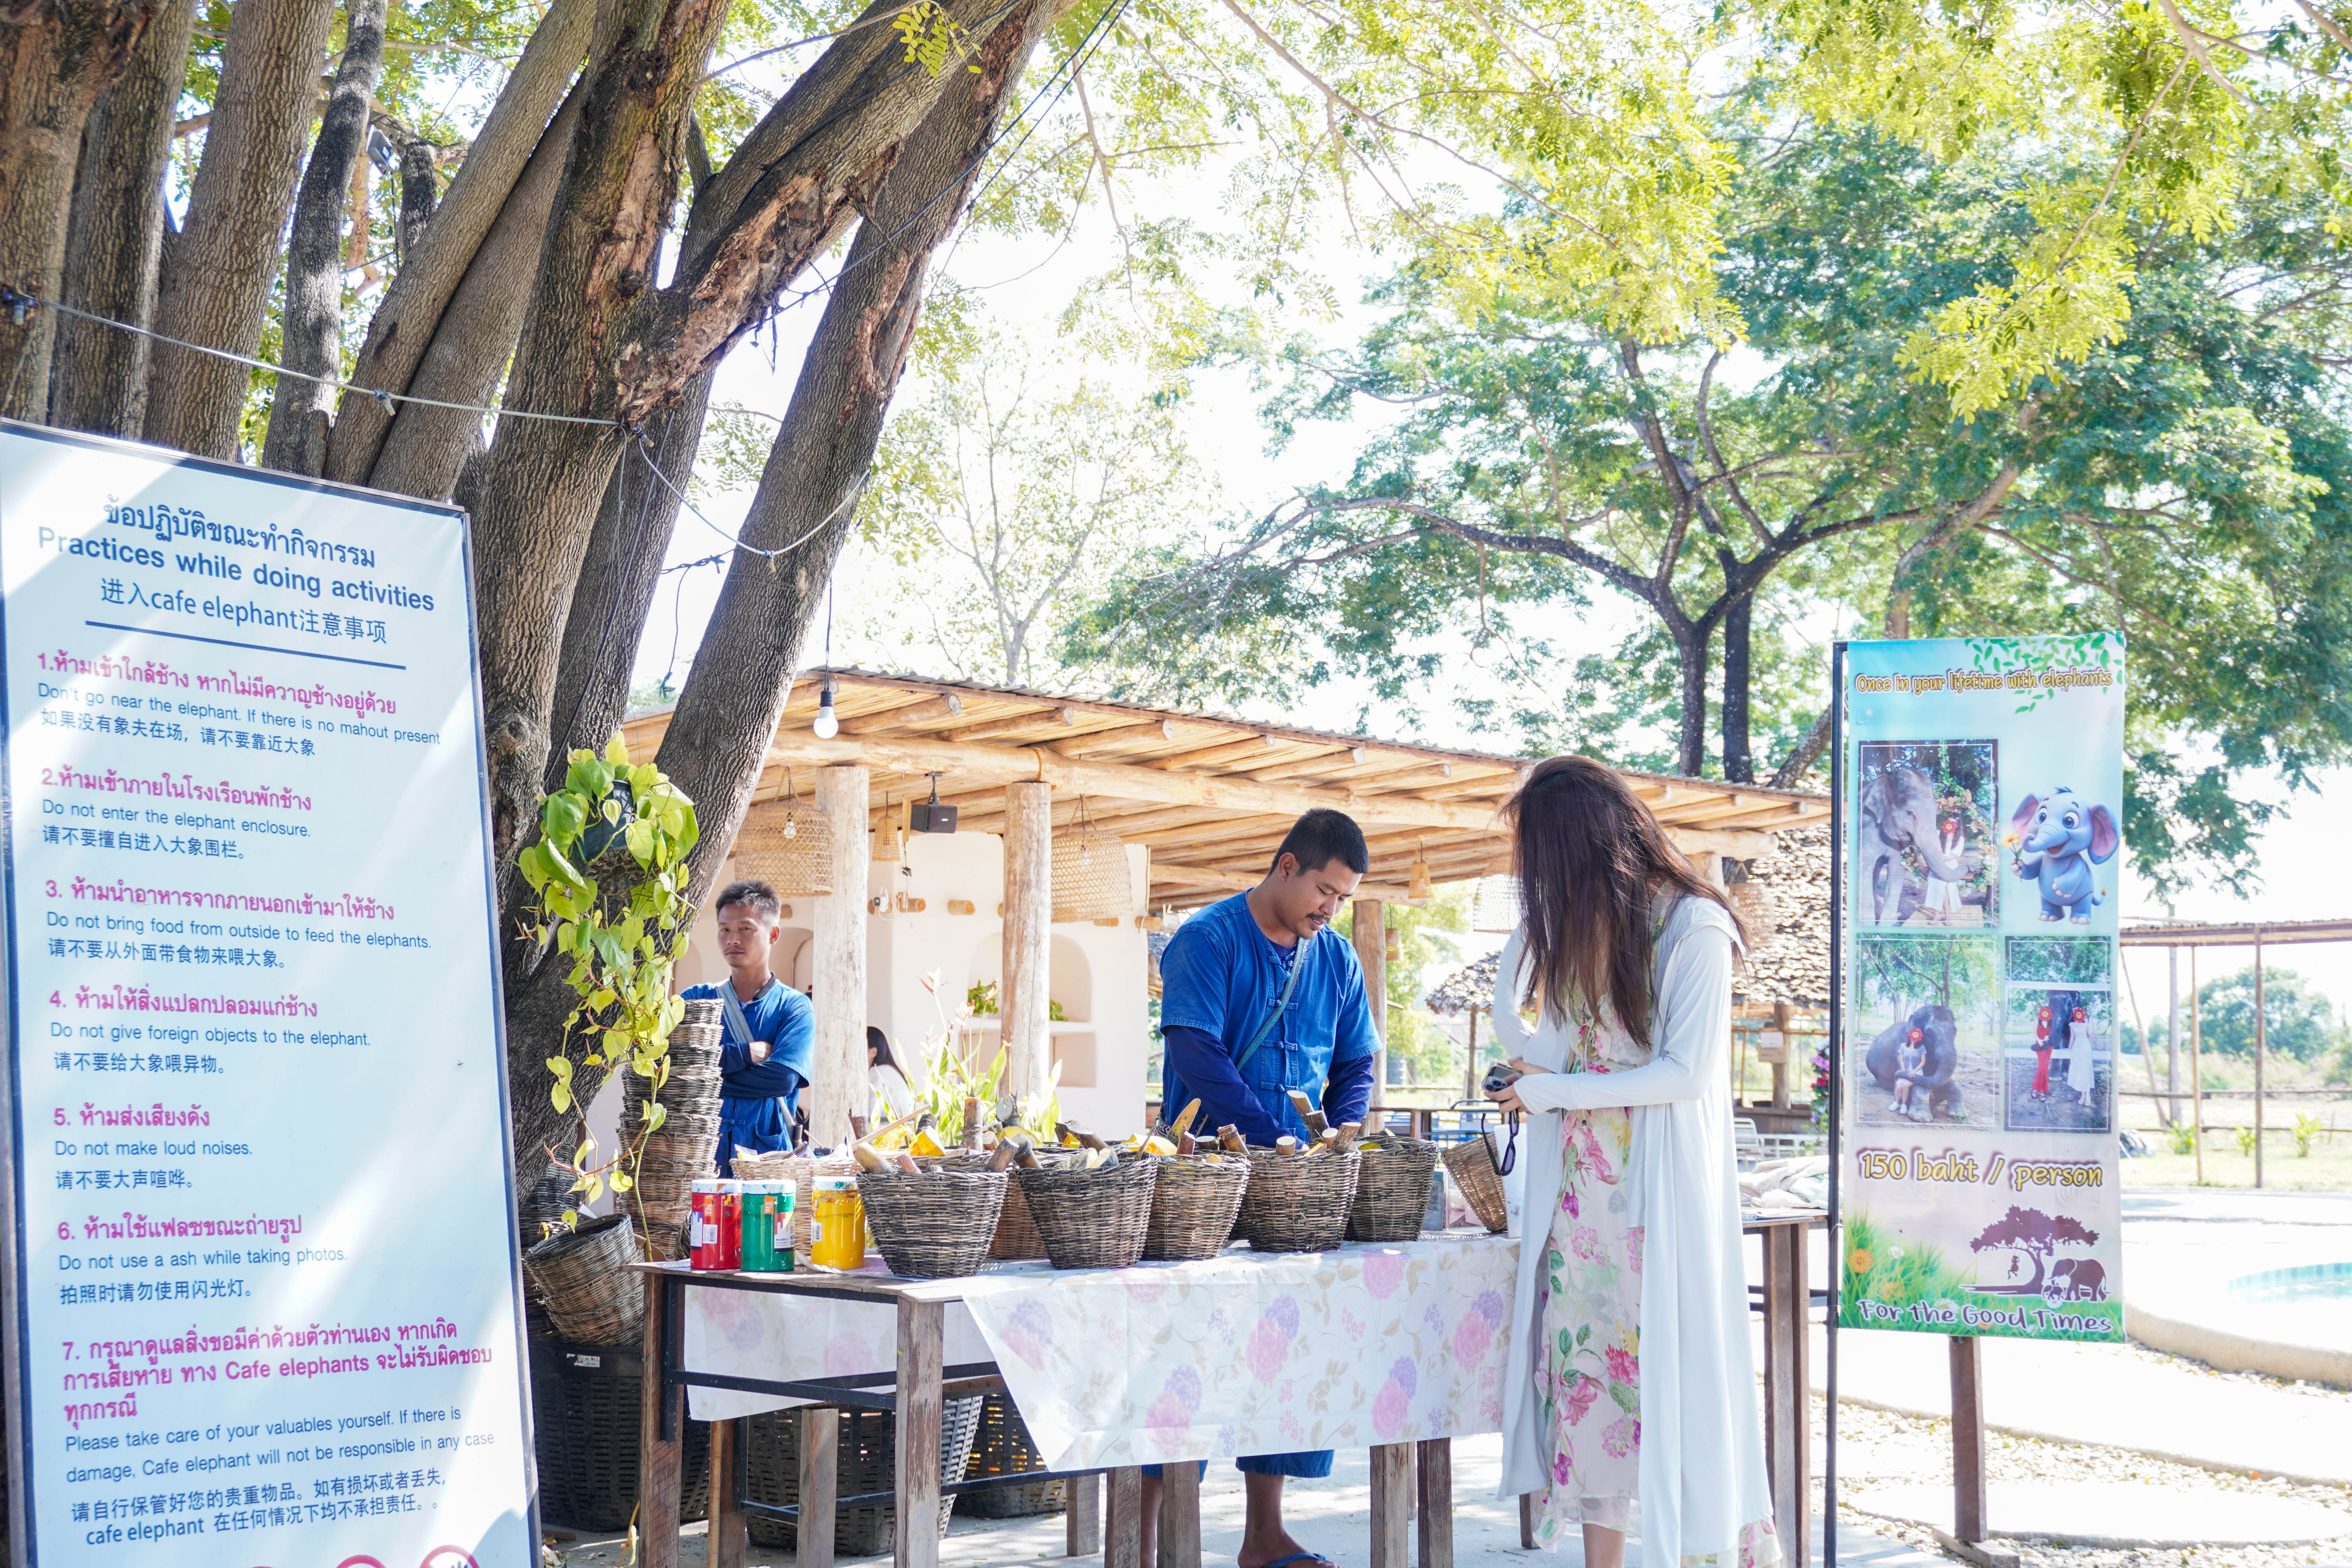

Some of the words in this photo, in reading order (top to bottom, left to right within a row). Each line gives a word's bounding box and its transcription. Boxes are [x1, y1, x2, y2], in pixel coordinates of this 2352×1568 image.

[39, 526, 165, 568] Practices
[175, 552, 242, 581] while
[253, 563, 321, 598] doing
[332, 580, 434, 611] activities
[1856, 675, 1892, 693] Once
[1895, 675, 1909, 691] in
[1913, 675, 1945, 695] your
[1949, 671, 2003, 694] lifetime
[2007, 669, 2038, 689] with
[2042, 667, 2113, 692] elephants
[38, 682, 78, 701] Don't
[86, 693, 104, 706] go
[111, 695, 143, 708] near
[149, 697, 172, 712] the
[178, 701, 241, 721] elephant.
[248, 709, 256, 722] If
[261, 711, 296, 727] there
[301, 715, 312, 729] is
[318, 721, 334, 732] no
[340, 722, 388, 739] mahout
[394, 730, 440, 744] present
[43, 799, 64, 815] Do
[71, 804, 95, 817] not
[102, 807, 139, 821] enter
[145, 809, 168, 824] the
[174, 812, 235, 830] elephant
[241, 820, 310, 837] enclosure.
[45, 880, 62, 898] 3.
[47, 911, 69, 927] Do
[75, 915, 100, 928] not
[106, 915, 144, 935] bring
[150, 918, 183, 934] food
[189, 920, 223, 936] from
[229, 925, 280, 939] outside
[285, 927, 299, 940] to
[305, 927, 334, 942] feed
[339, 930, 361, 944] the
[367, 932, 431, 949] elephants.
[49, 990, 66, 1007] 4.
[51, 1022, 72, 1037] Do
[80, 1025, 104, 1038] not
[111, 1024, 142, 1042] give
[147, 1025, 199, 1044] foreign
[205, 1027, 257, 1045] objects
[263, 1030, 277, 1043] to
[283, 1030, 304, 1044] the
[310, 1031, 370, 1048] elephant.
[54, 1108, 71, 1126] 5.
[55, 1140, 77, 1155] Do
[84, 1142, 109, 1155] not
[116, 1140, 157, 1155] make
[164, 1140, 195, 1155] loud
[202, 1140, 252, 1155] noises.
[1862, 1152, 1907, 1180] 150
[1916, 1152, 1979, 1183] baht
[1988, 1157, 2004, 1185] /
[2014, 1165, 2103, 1192] person
[58, 1221, 75, 1240] 6.
[59, 1255, 81, 1270] Do
[88, 1254, 114, 1269] not
[121, 1256, 148, 1268] use
[154, 1255, 164, 1267] a
[170, 1251, 196, 1266] ash
[203, 1250, 241, 1265] while
[247, 1249, 290, 1266] taking
[297, 1248, 347, 1265] photos.
[1859, 1300, 1902, 1321] For
[1908, 1300, 1956, 1323] the
[1963, 1306, 2028, 1329] Good
[2032, 1309, 2112, 1332] Times
[62, 1341, 80, 1360] 7.
[397, 1317, 457, 1341] หากเกิด
[64, 1362, 172, 1391] การเสียหาย
[180, 1365, 216, 1383] ทาง
[225, 1360, 270, 1380] Cafe
[279, 1355, 369, 1379] elephants
[64, 1392, 138, 1430] ทุกกรณี
[65, 1436, 119, 1452] Please
[125, 1431, 159, 1446] take
[166, 1430, 199, 1443] care
[206, 1424, 221, 1440] of
[227, 1425, 260, 1442] your
[265, 1417, 332, 1435] valuables
[338, 1411, 394, 1433] yourself.
[399, 1410, 407, 1424] If
[412, 1409, 445, 1423] there
[451, 1406, 461, 1419] is
[66, 1466, 135, 1483] damage,
[142, 1458, 179, 1475] Cafe
[185, 1452, 250, 1474] elephant
[256, 1449, 280, 1465] will
[287, 1447, 310, 1463] not
[316, 1446, 333, 1460] be
[339, 1438, 415, 1460] responsible
[421, 1436, 432, 1450] in
[437, 1437, 459, 1450] any
[465, 1434, 497, 1446] case.
[86, 1524, 122, 1545] cafe
[127, 1518, 204, 1543] elephant
